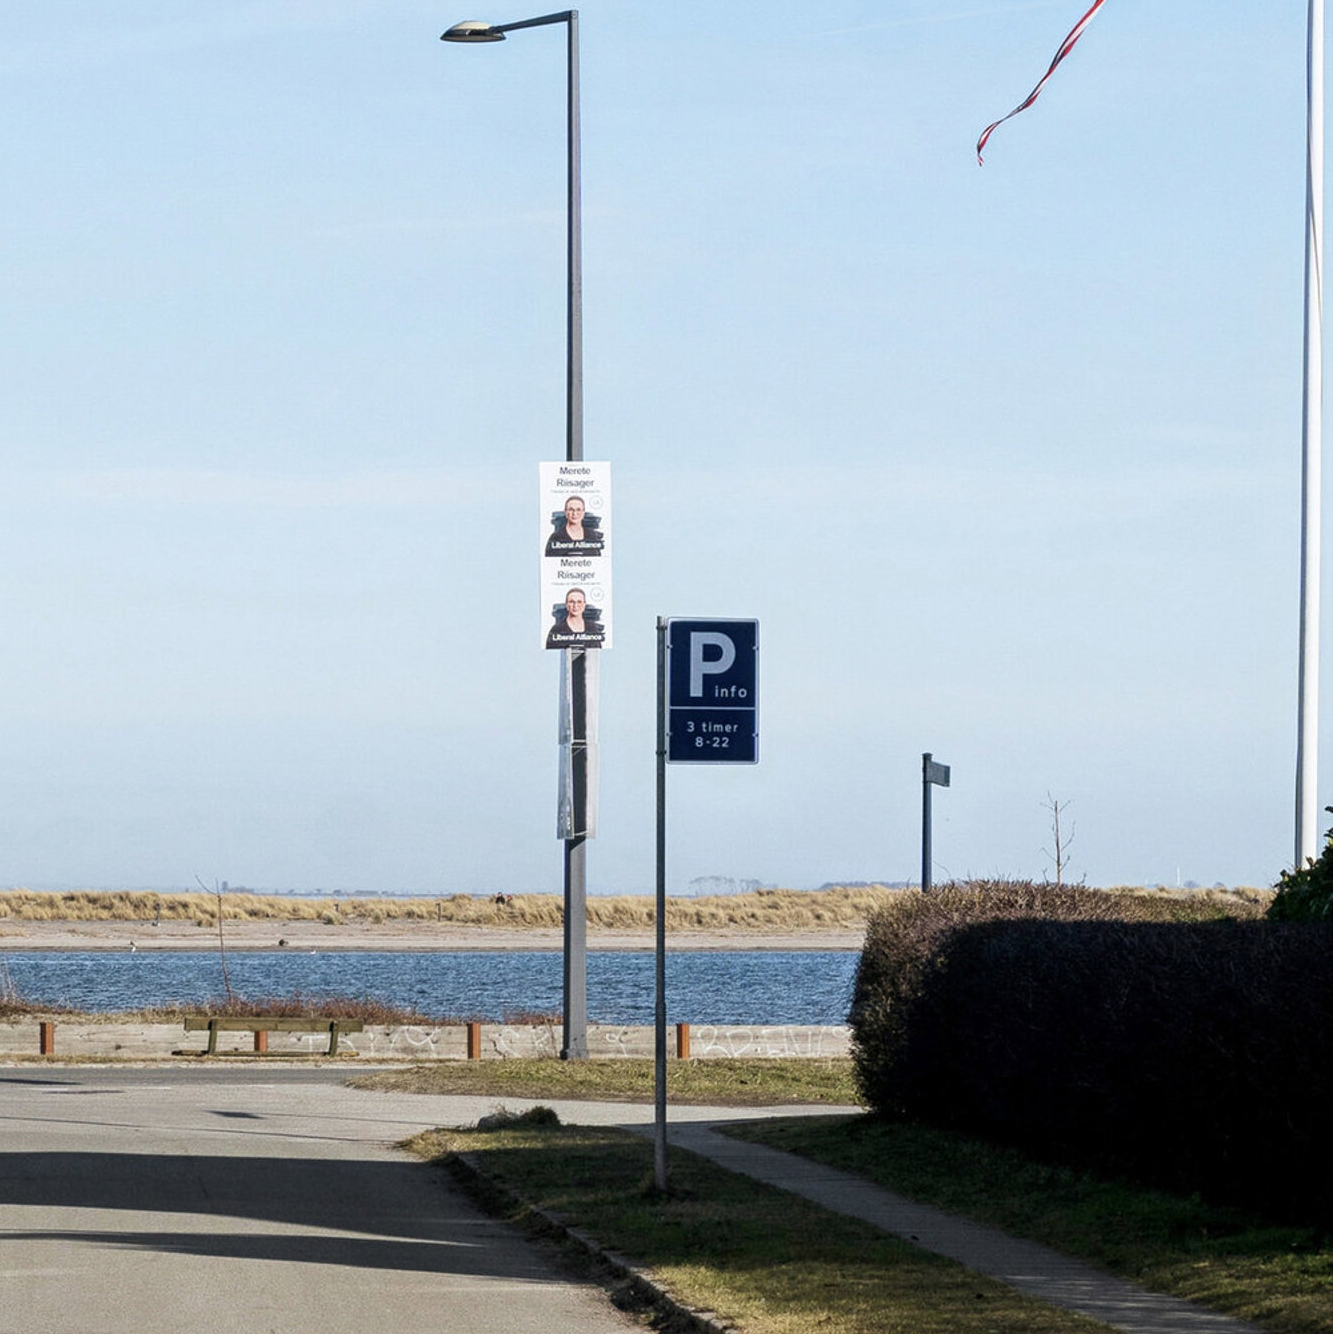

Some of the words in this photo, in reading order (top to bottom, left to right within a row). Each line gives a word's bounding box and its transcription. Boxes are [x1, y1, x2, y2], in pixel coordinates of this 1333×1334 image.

[559, 466, 591, 475] Merete
[556, 478, 594, 489] Riisager
[551, 541, 574, 549] Liberal
[575, 541, 602, 549] Alliance
[560, 558, 592, 567] Merete
[557, 570, 595, 581] Riisager
[552, 633, 574, 641] Liberal
[576, 633, 603, 641] Alliance
[690, 631, 736, 698] P
[714, 685, 747, 698] info
[687, 721, 695, 732] 3
[702, 722, 739, 733] timer
[695, 737, 730, 748] 8-22
